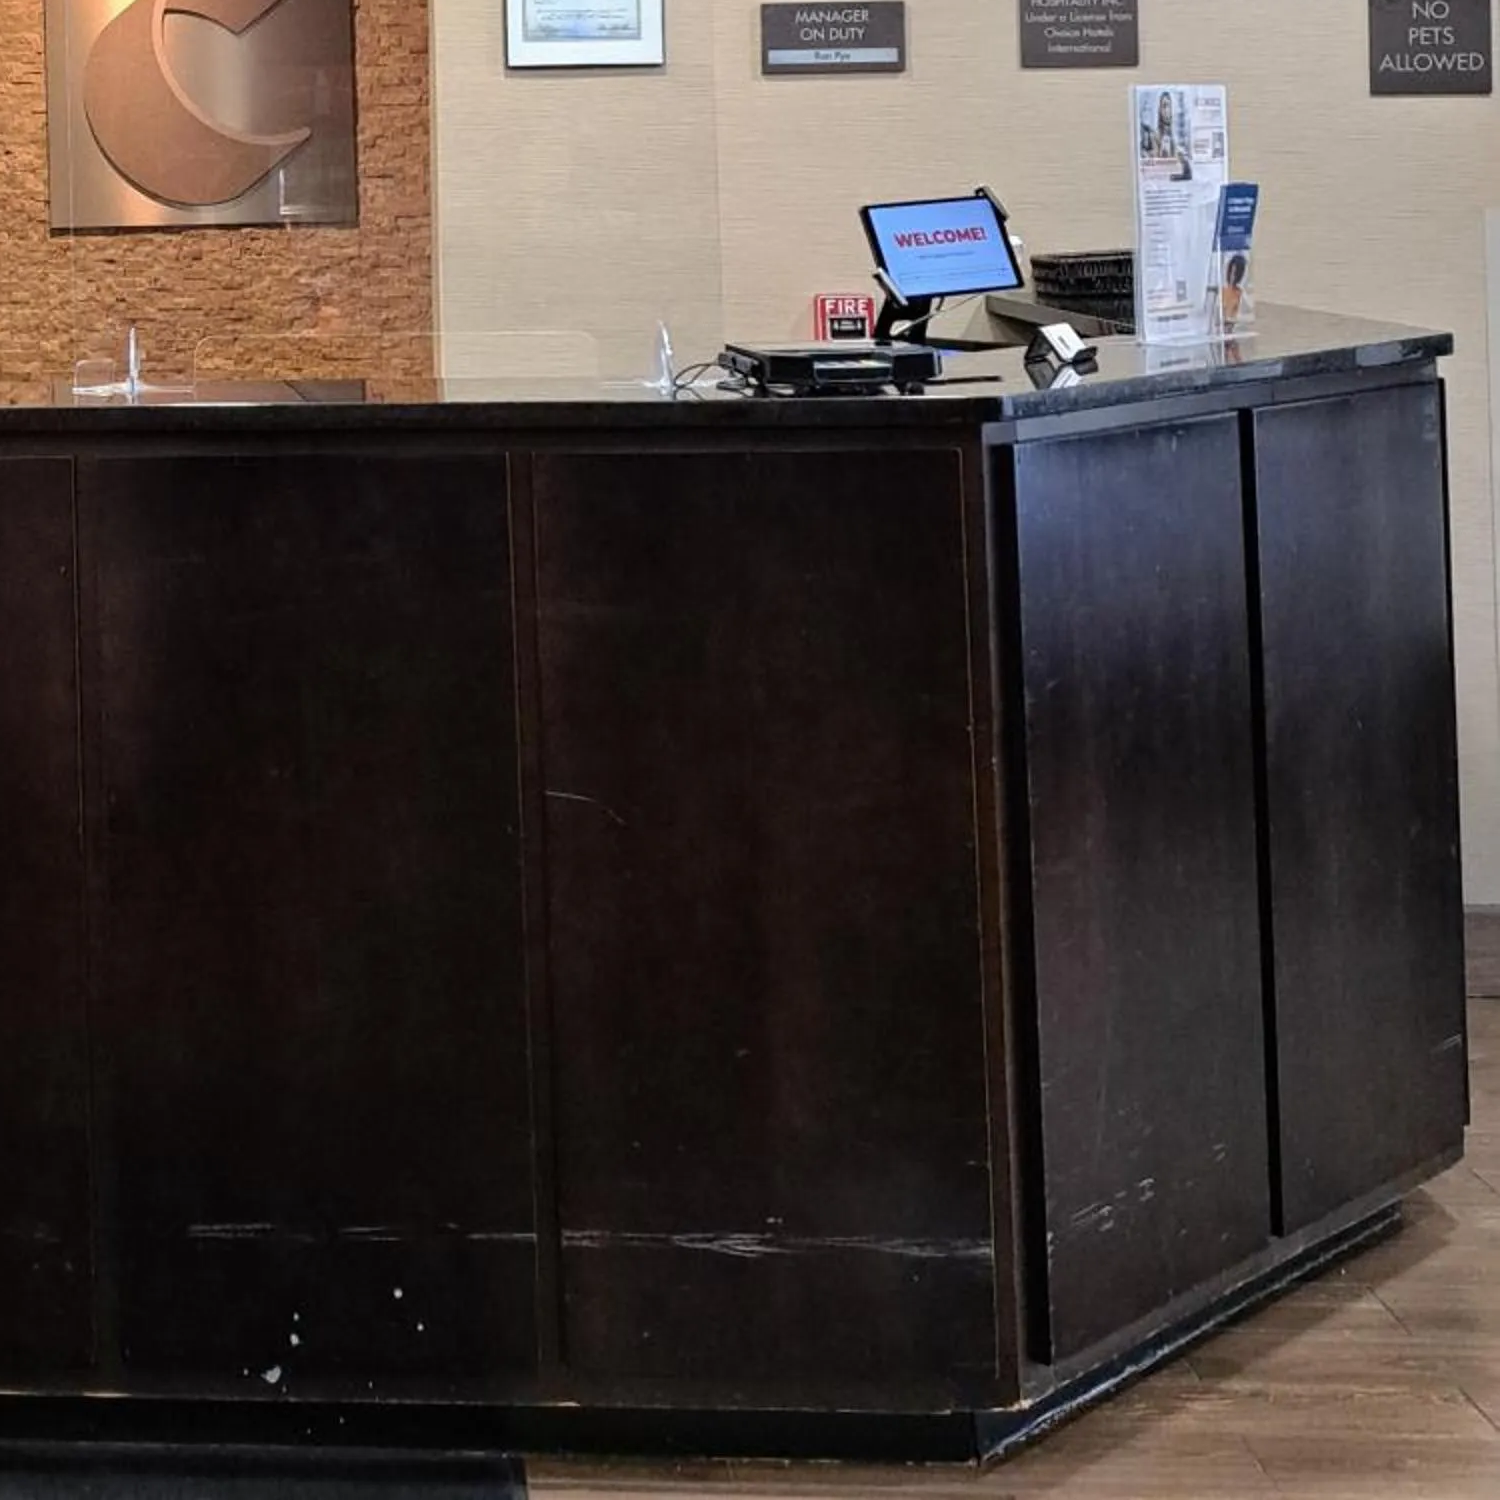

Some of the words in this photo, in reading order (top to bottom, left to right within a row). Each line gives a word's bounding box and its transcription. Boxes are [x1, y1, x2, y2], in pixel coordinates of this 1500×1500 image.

[794, 8, 869, 24] MANAGER
[1025, 11, 1057, 22] Under
[1411, 0, 1451, 20] NO
[800, 27, 825, 41] ON
[829, 27, 865, 41] DUTY
[1408, 26, 1455, 46] PETS
[1047, 41, 1112, 53] International
[1379, 52, 1485, 73] ALLOWED
[893, 226, 988, 248] WELCOME!
[825, 299, 869, 314] FIRE
